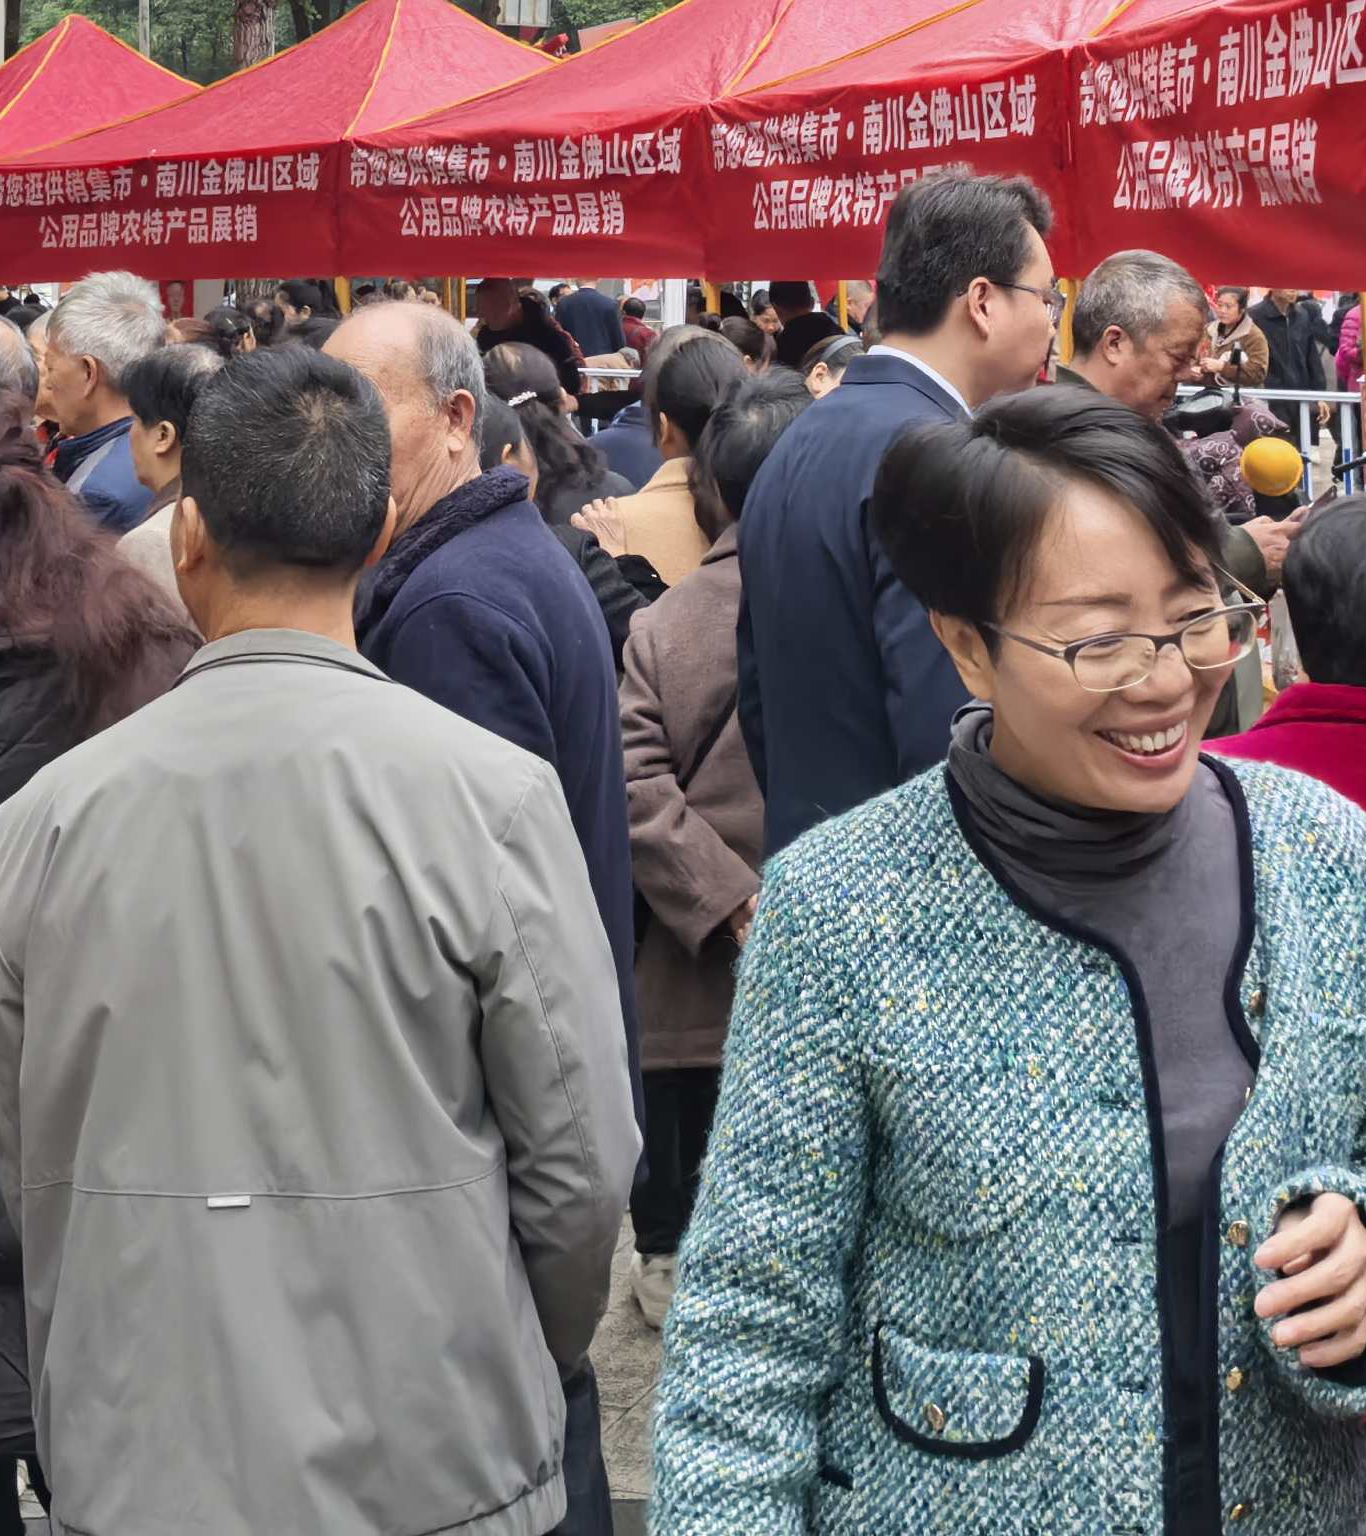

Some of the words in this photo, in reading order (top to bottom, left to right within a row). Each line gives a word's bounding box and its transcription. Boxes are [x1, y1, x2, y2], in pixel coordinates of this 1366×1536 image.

[1113, 116, 1323, 211] 公用品牌农特产品展销
[398, 189, 625, 238] 公用品牌农特产品展销
[752, 160, 975, 232] 公用品牌农特产
[38, 203, 259, 250] 公用品牌农特产品展销
